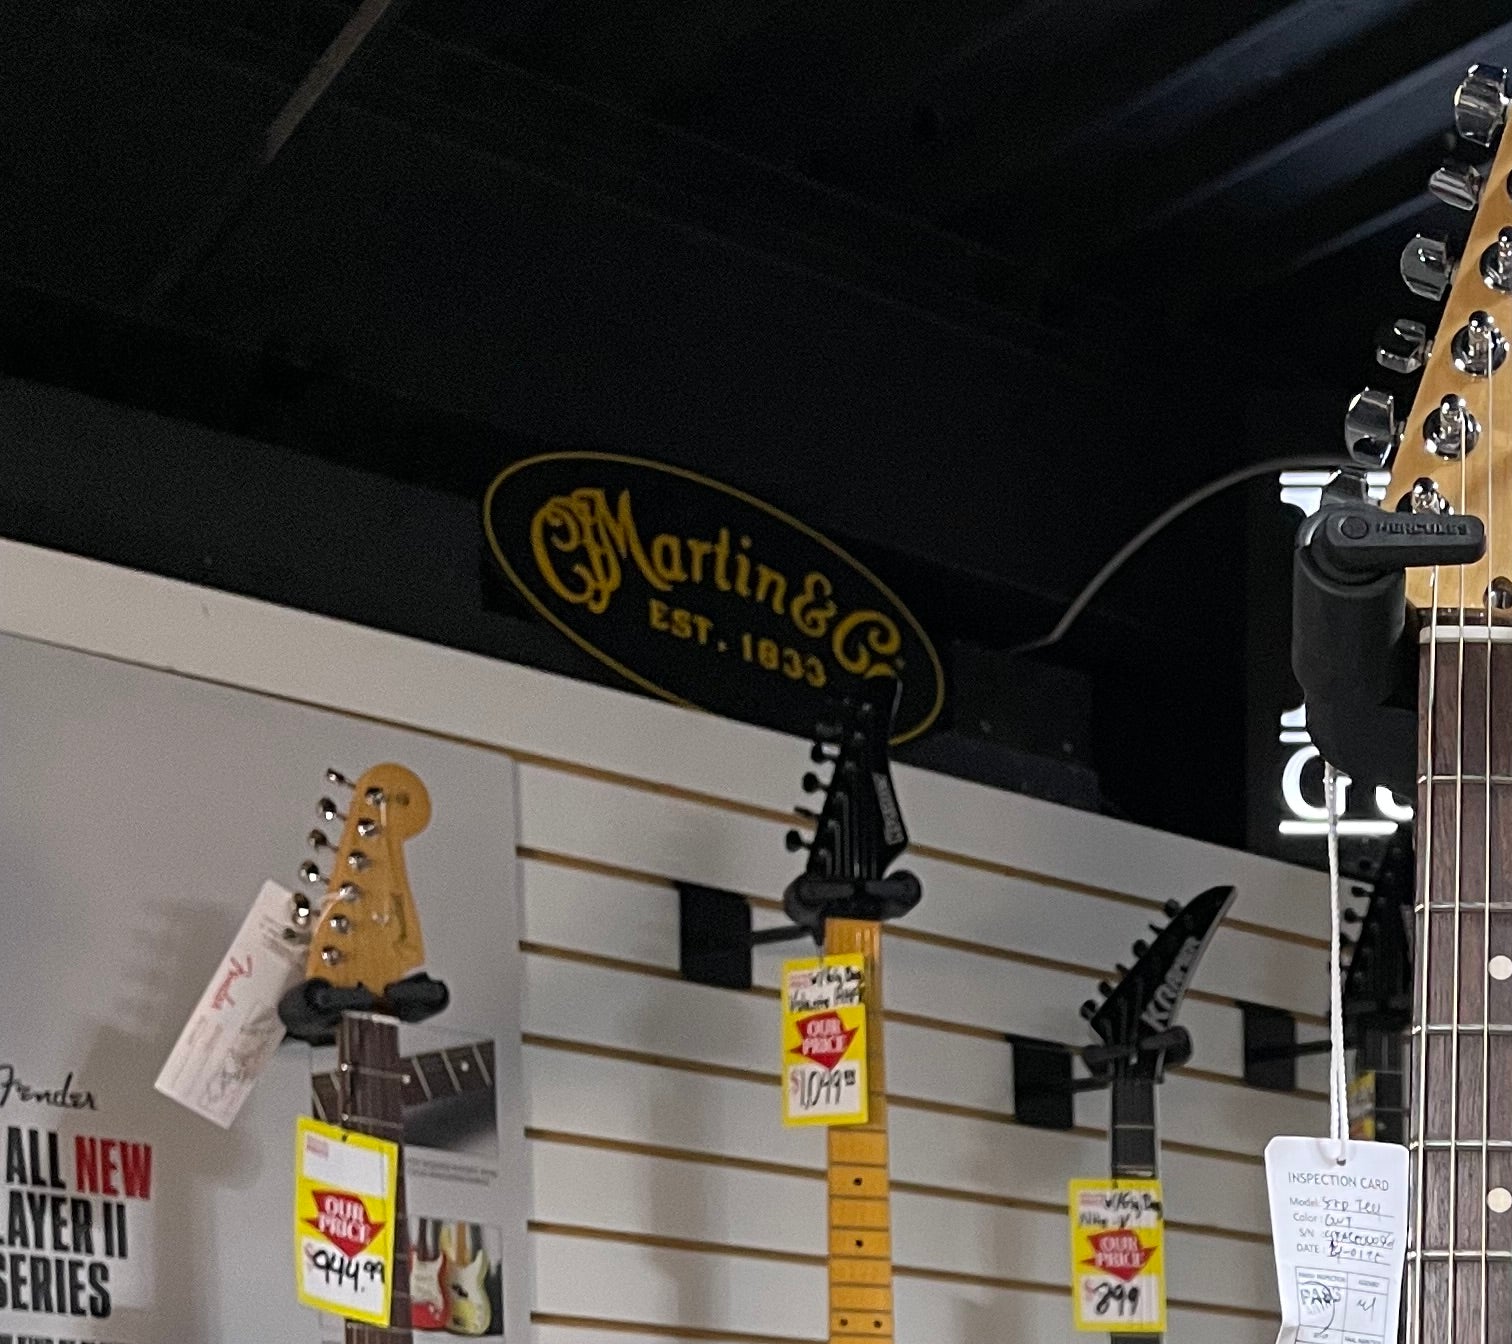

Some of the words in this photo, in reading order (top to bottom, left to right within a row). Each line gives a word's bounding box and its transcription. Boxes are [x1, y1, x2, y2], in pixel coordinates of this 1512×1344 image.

[1375, 522, 1469, 536] HERCULES
[741, 632, 828, 688] 1833
[806, 1017, 842, 1037] OUR
[802, 1034, 848, 1055] PRICE
[6, 1125, 67, 1190] ALL
[74, 1134, 152, 1201] NEW
[1287, 1171, 1357, 1188] INSPECTION
[1359, 1177, 1389, 1192] CARD
[324, 1195, 365, 1222] OUR
[0, 1190, 95, 1257] AYER
[318, 1214, 370, 1244] PRICE
[1100, 1236, 1138, 1252] OUR
[1095, 1250, 1145, 1269] PRICE
